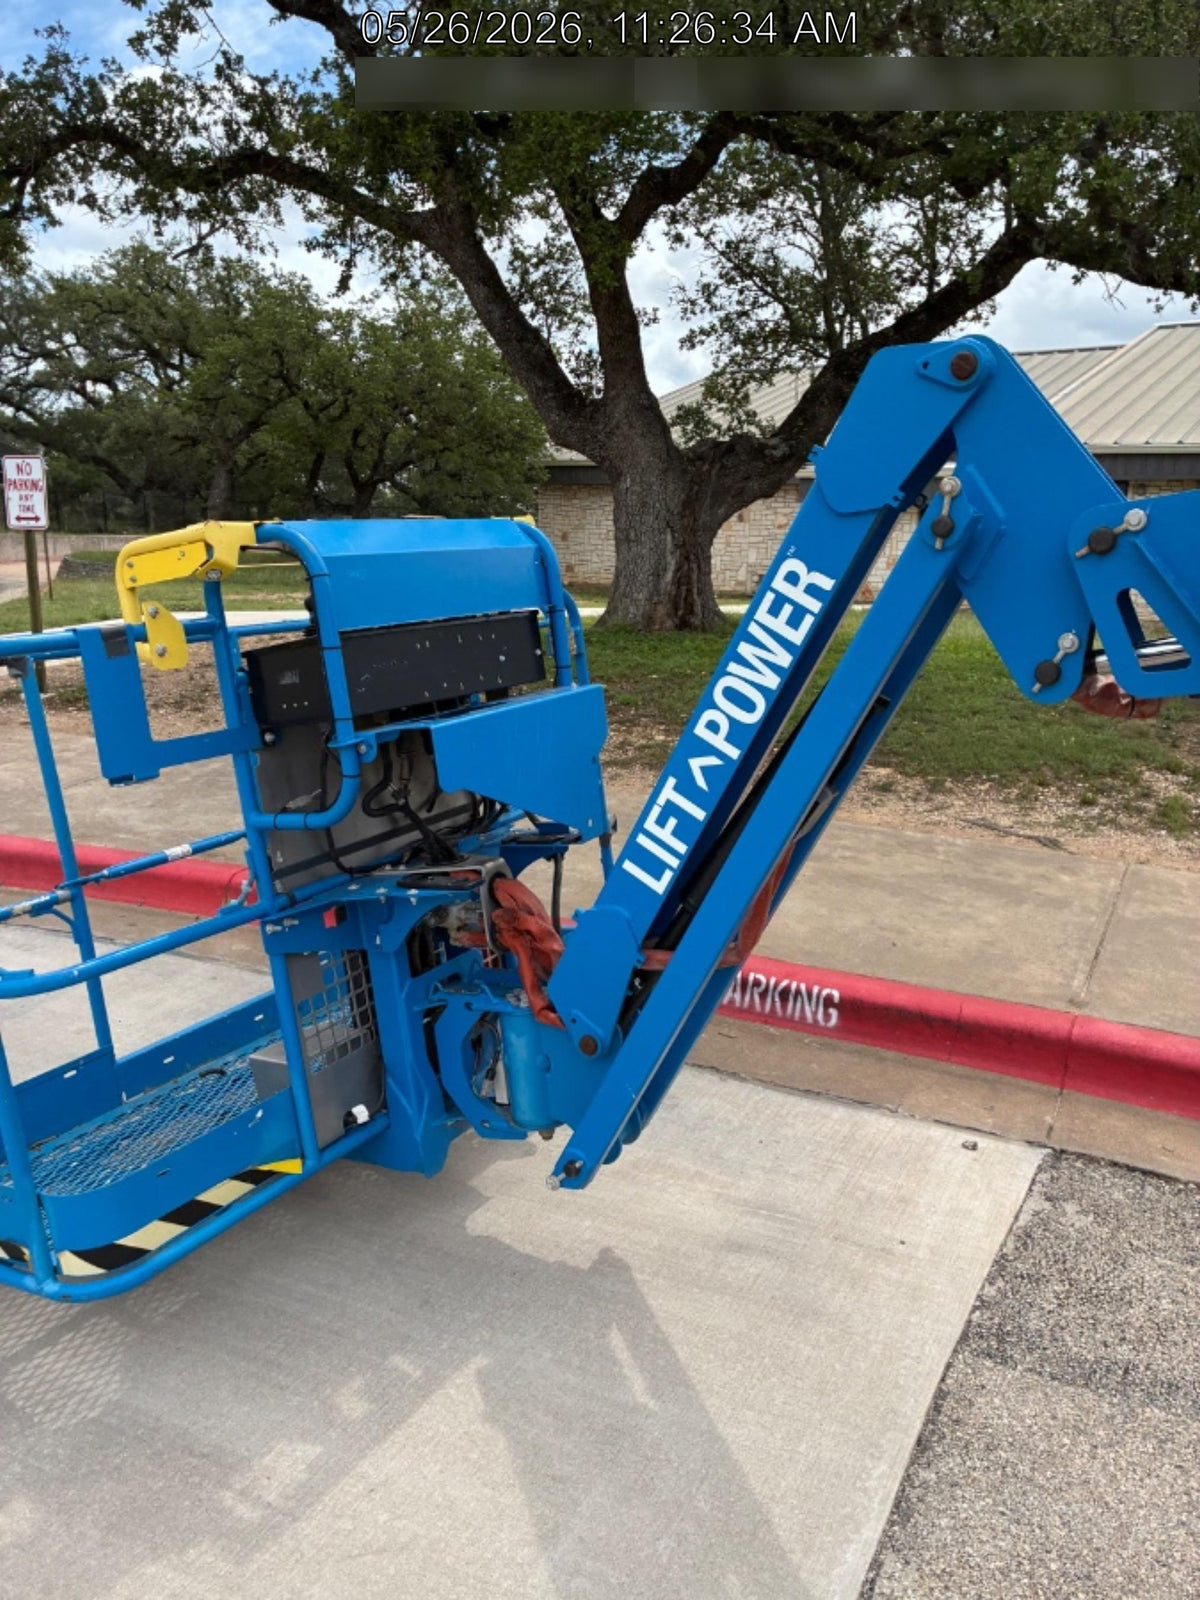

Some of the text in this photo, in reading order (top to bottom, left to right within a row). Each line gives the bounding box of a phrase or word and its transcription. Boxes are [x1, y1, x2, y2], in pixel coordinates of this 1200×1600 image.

[8, 478, 43, 492] PARKING
[16, 462, 32, 476] NO
[621, 775, 707, 896] LIFT
[693, 556, 836, 761] POWER
[722, 969, 840, 1028] ARKING
